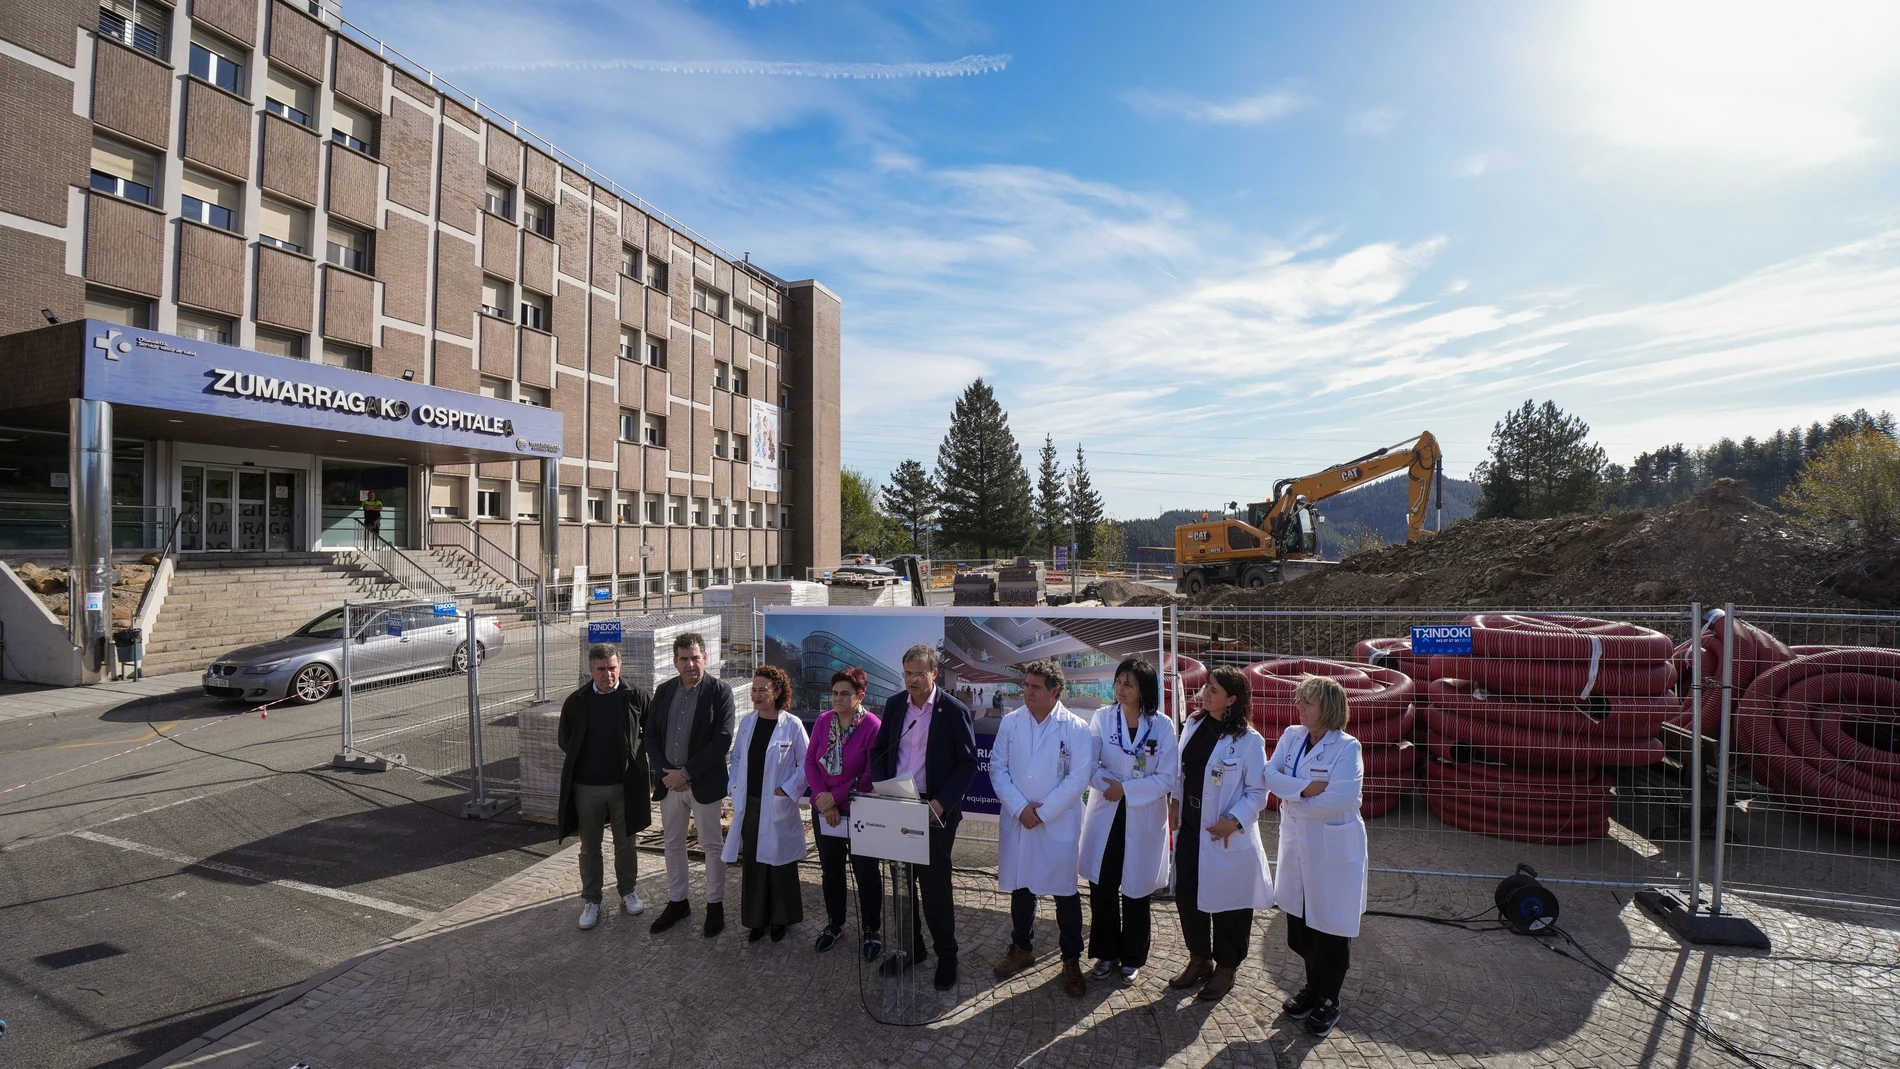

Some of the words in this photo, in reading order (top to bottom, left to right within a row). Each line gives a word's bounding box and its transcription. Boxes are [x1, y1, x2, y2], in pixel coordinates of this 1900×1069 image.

[214, 368, 409, 419] ZUMARRAGAKO
[419, 404, 515, 436] OSPITALEA
[1341, 467, 1358, 482] CAT
[181, 521, 291, 535] ZUMARAGA
[1193, 531, 1208, 541] CAT
[590, 623, 620, 631] TXINDOKI
[1413, 627, 1471, 638] TXINDOKI
